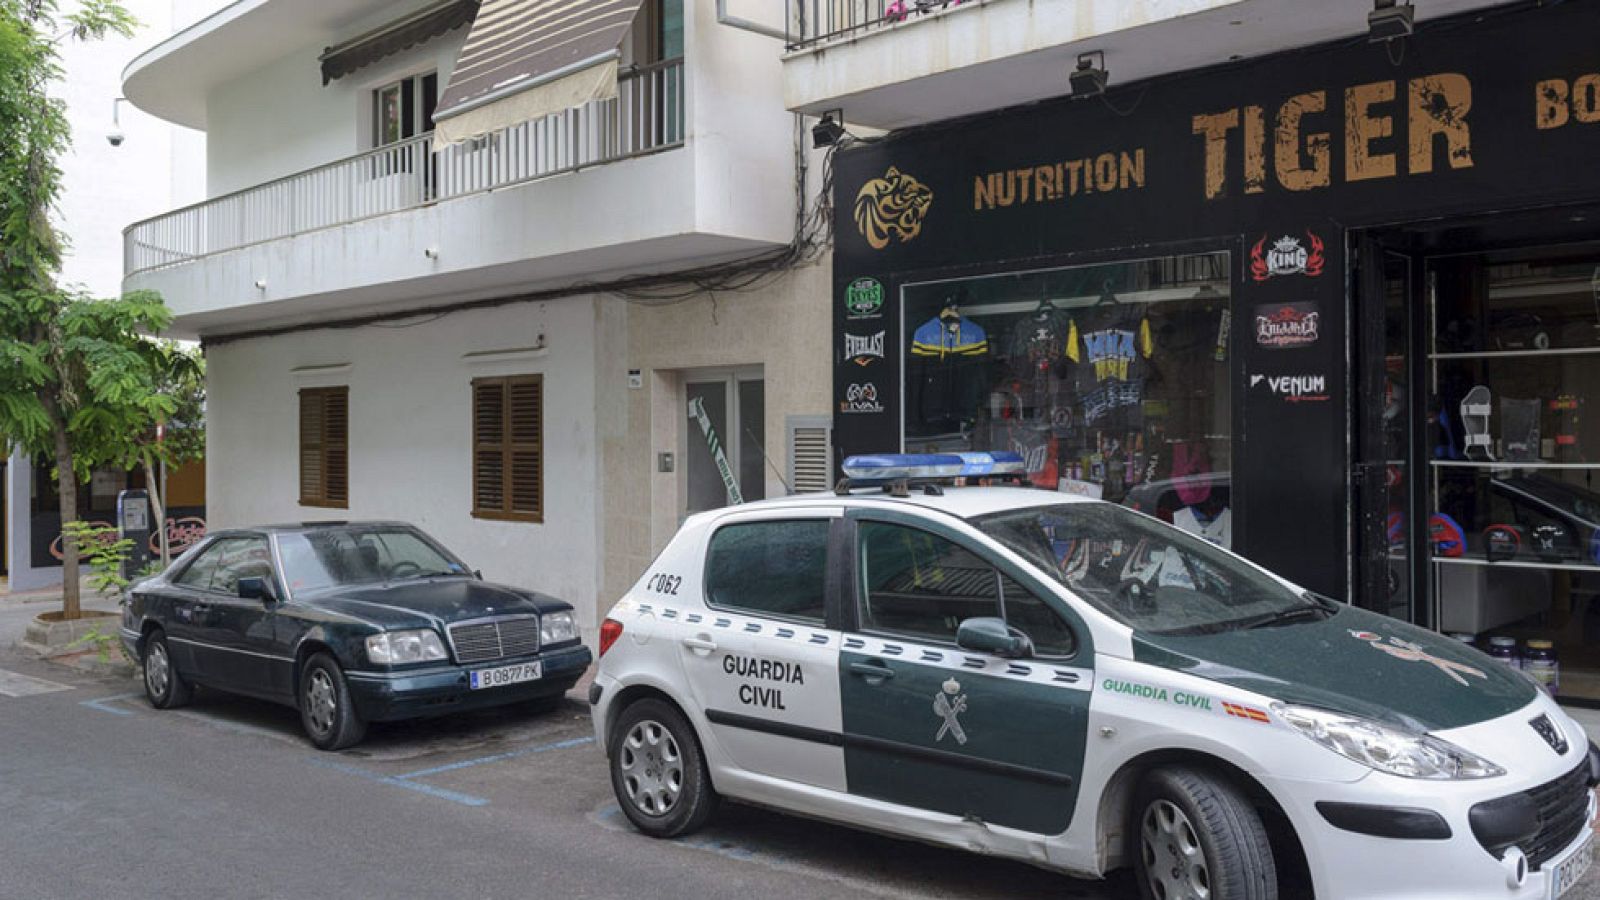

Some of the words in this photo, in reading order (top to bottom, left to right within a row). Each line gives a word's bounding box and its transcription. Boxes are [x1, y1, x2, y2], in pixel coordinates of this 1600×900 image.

[974, 148, 1146, 211] NUTRITION
[1192, 73, 1475, 200] TIGER
[1266, 247, 1308, 274] KING
[844, 330, 886, 361] EVERLAST
[1268, 375, 1325, 396] VENUM
[841, 400, 884, 411] RIVAL
[656, 574, 682, 596] 062
[483, 671, 492, 685] B
[524, 664, 538, 678] PK
[722, 654, 804, 686] GUARDIA
[739, 684, 786, 711] CIVIL
[1102, 679, 1168, 701] GUARDIA
[1173, 691, 1213, 712] CIVIL
